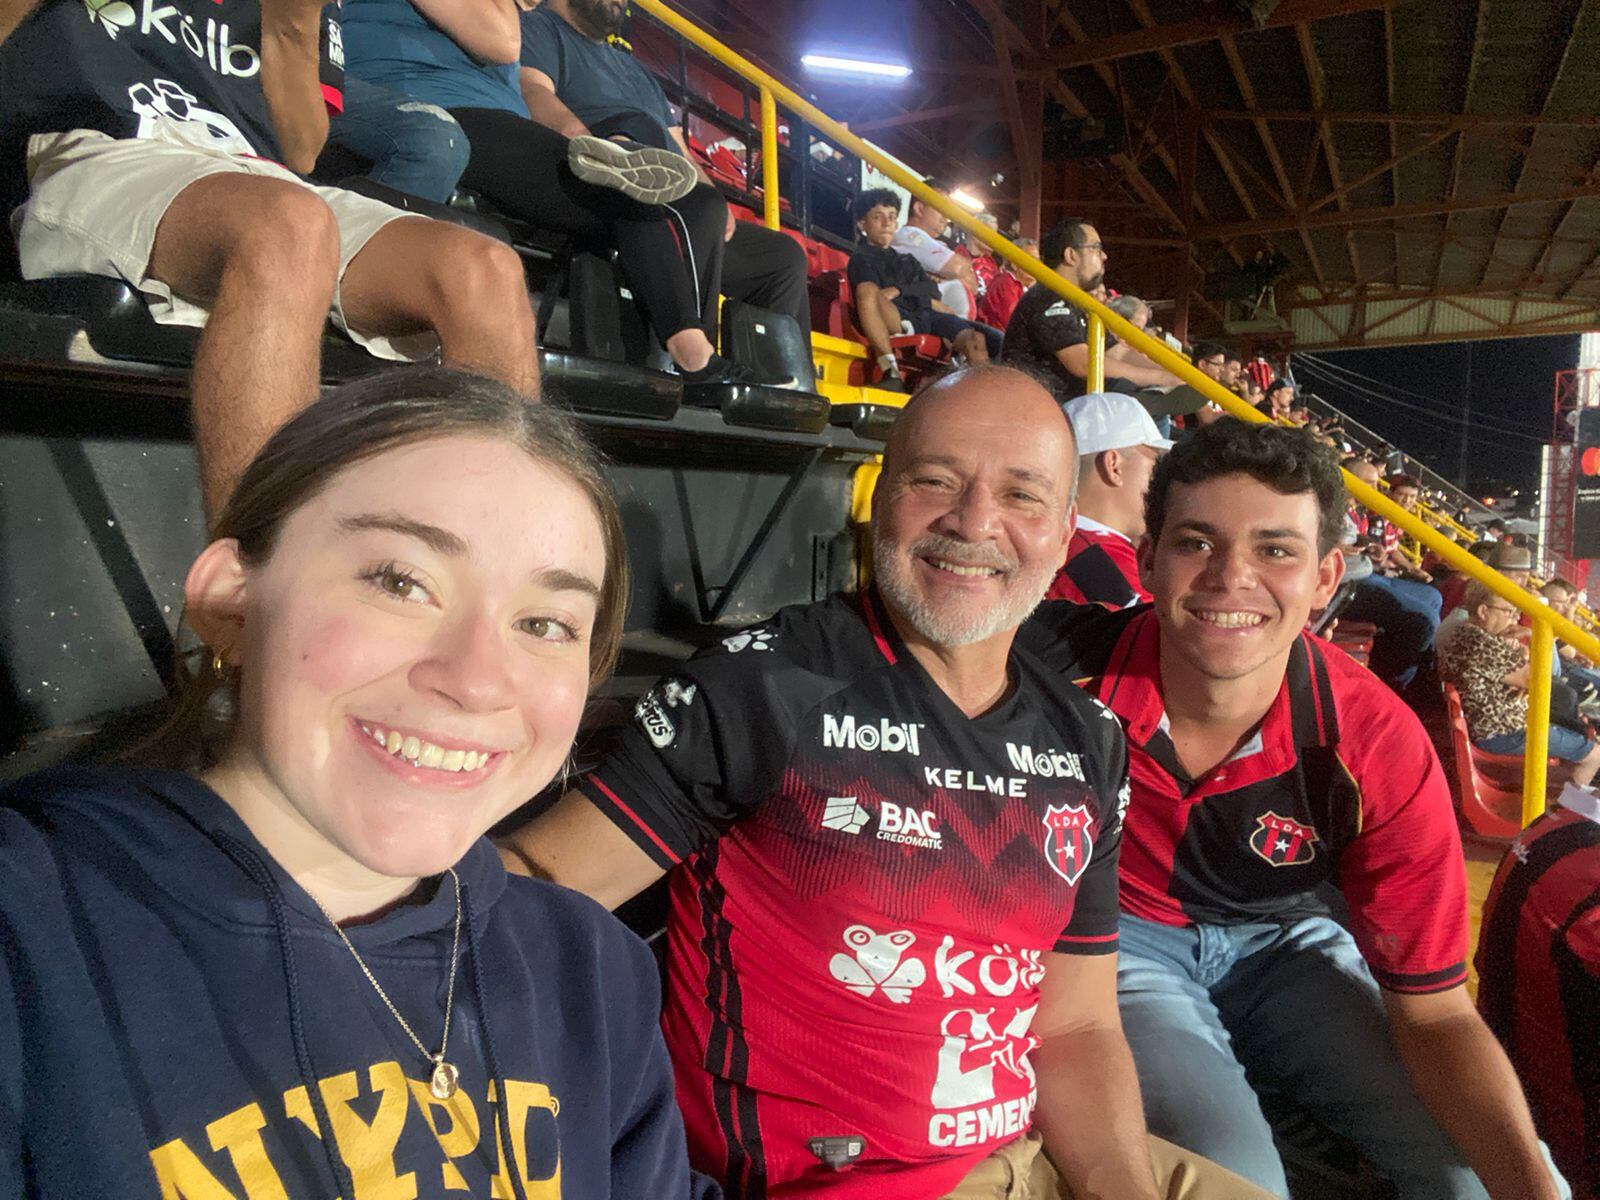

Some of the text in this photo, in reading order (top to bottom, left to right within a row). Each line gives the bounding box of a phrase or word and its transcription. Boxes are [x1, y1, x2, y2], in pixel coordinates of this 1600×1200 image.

[823, 713, 920, 756] Mobil
[924, 766, 1027, 798] KELME
[878, 801, 941, 839] BAC
[1054, 816, 1079, 827] LDA
[1271, 819, 1303, 838] LDA
[876, 830, 942, 850] CREDOMATIC
[149, 1061, 562, 1200] NYPD
[928, 1087, 1037, 1147] CEMEN
